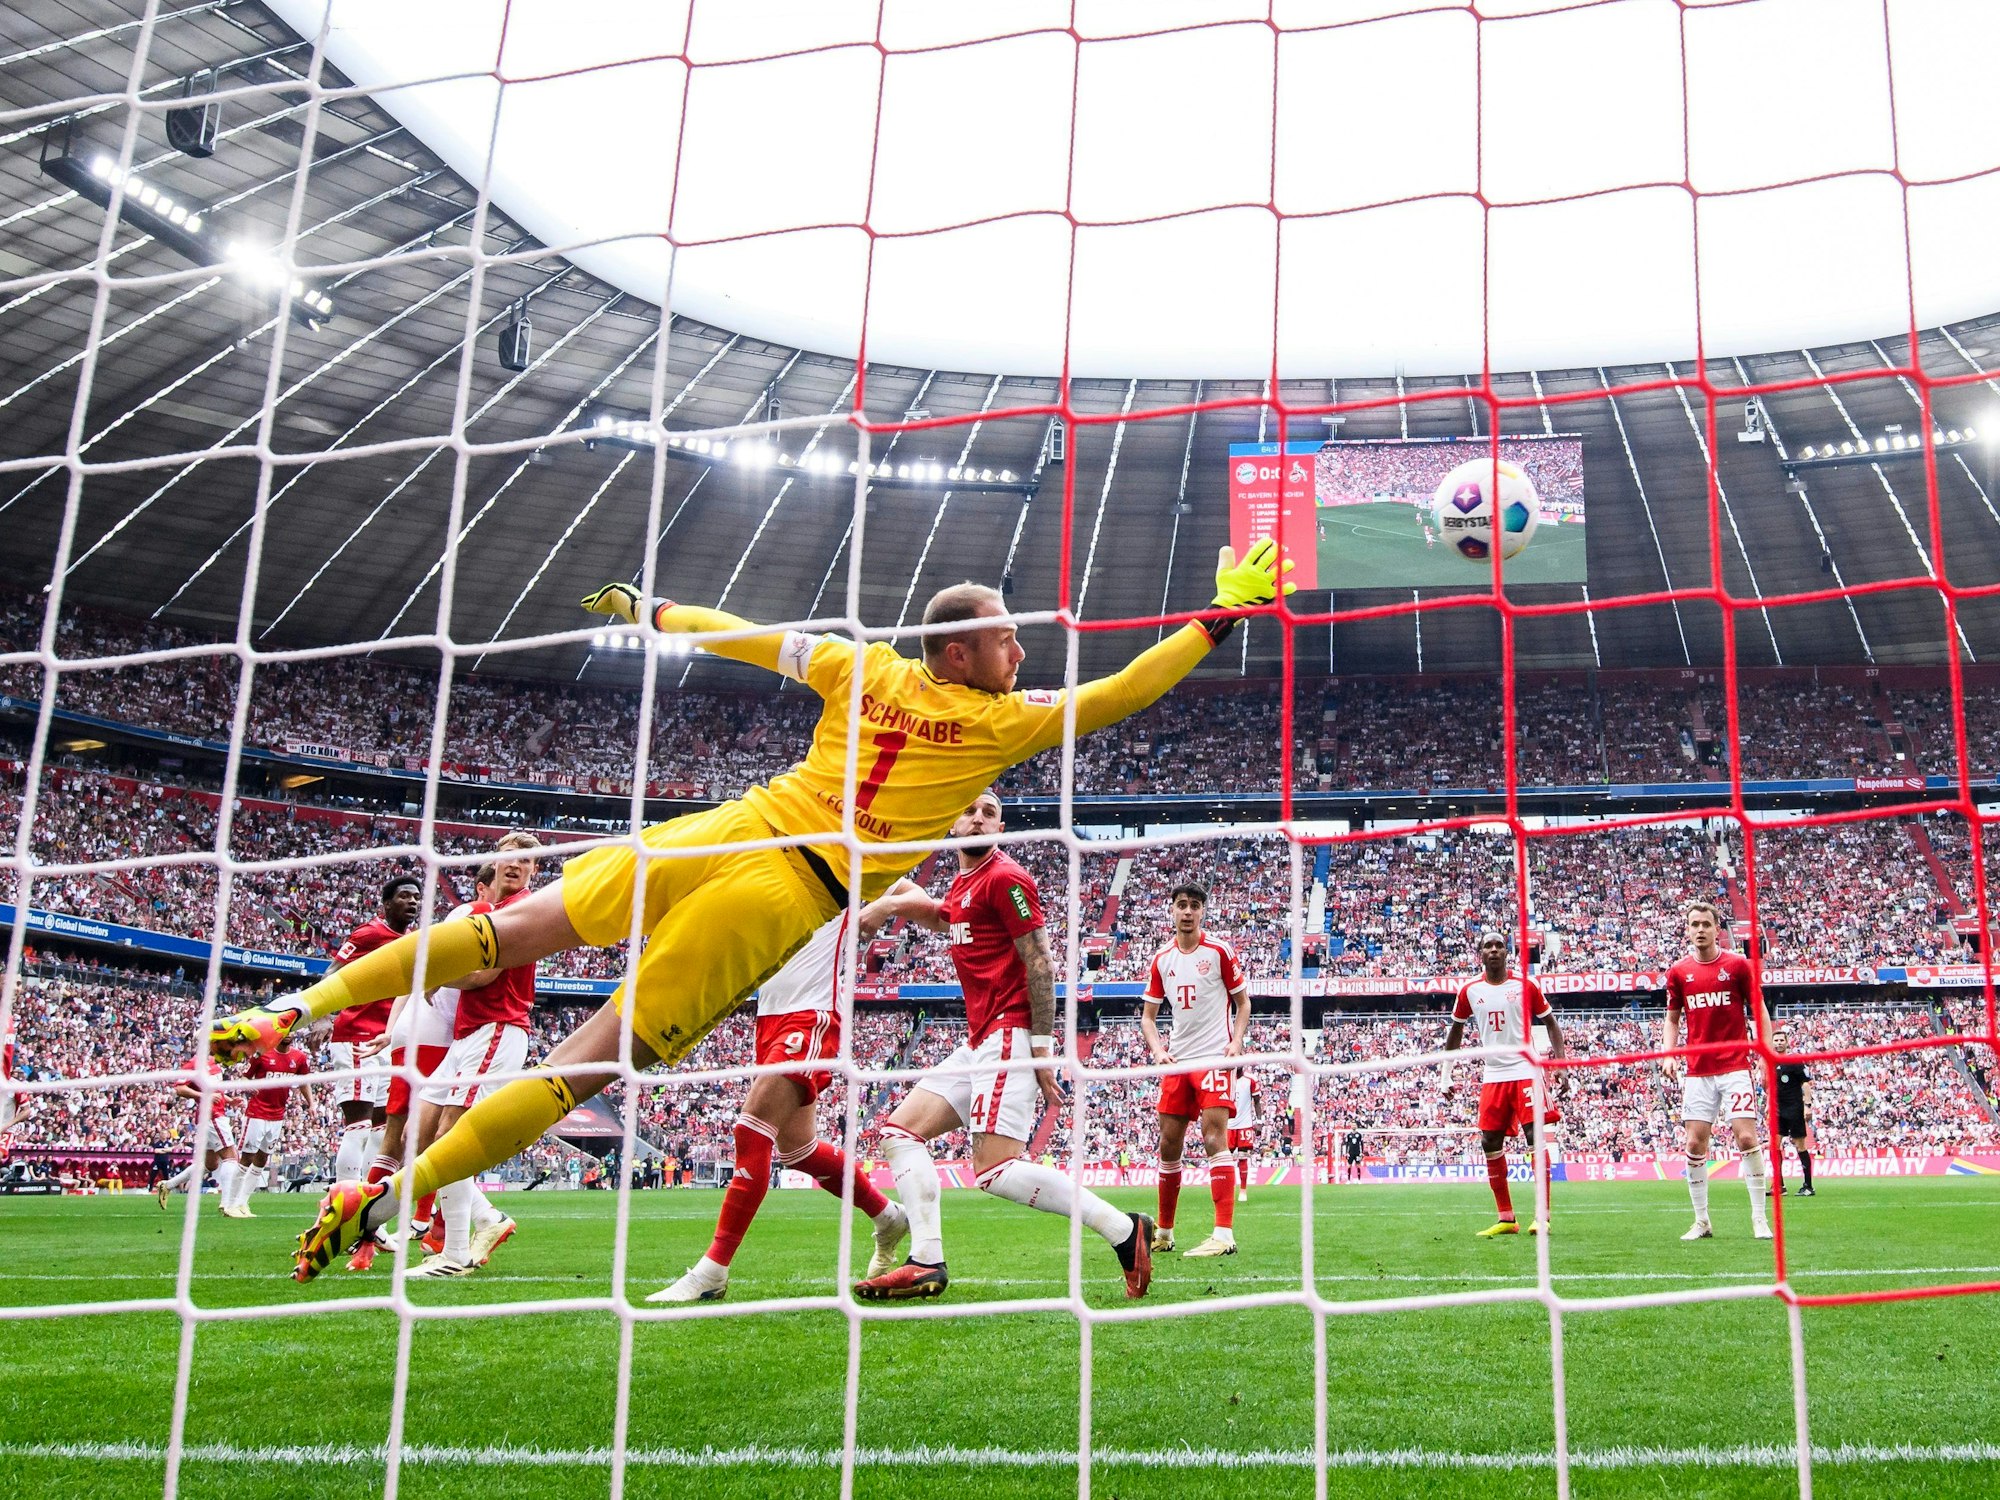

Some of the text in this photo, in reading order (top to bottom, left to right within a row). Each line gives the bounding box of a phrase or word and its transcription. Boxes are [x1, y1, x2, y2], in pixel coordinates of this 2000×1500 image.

[860, 694, 963, 744] SCHWABE
[318, 744, 340, 758] KÖLN
[855, 730, 909, 812] 1
[1011, 885, 1031, 918] DEVK
[26, 912, 109, 937] llianz Global Investors
[223, 949, 306, 969] Allianz Global Investors
[535, 980, 594, 991] obal Investors
[1540, 974, 1633, 993] REDSIDE
[1761, 968, 1854, 984] OBERPFALZ
[1939, 977, 1958, 985] Bazi
[1686, 991, 1731, 1010] REWE
[784, 1031, 805, 1055] 9
[1201, 1070, 1229, 1093] 45
[1731, 1092, 1754, 1112] 22
[1240, 1130, 1251, 1141] 19
[1445, 1165, 1488, 1178] EUR
[1813, 1157, 1900, 1177] MAGENTA
[1903, 1157, 1928, 1175] TV
[1082, 1168, 1117, 1186] DER
